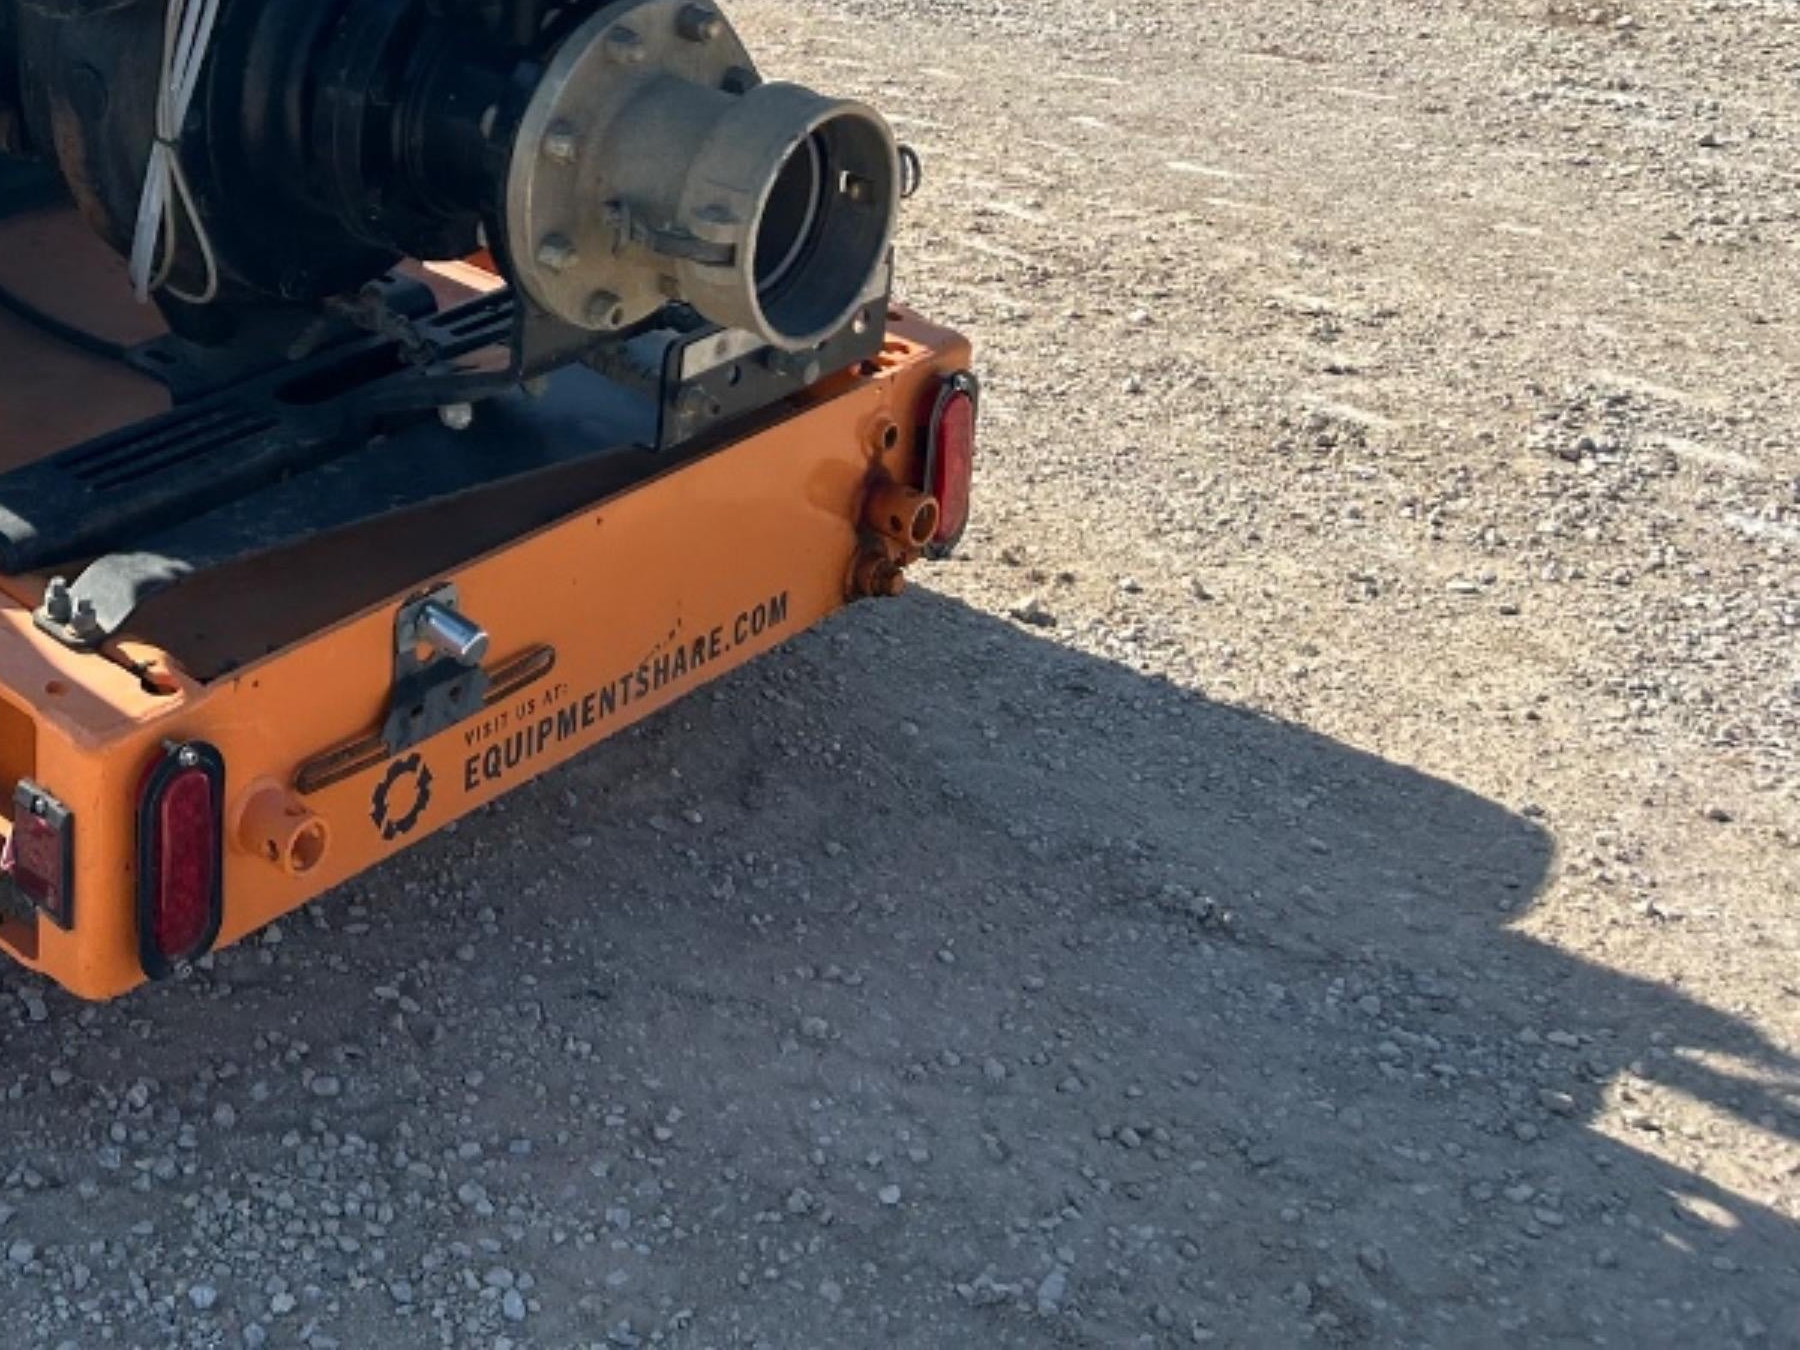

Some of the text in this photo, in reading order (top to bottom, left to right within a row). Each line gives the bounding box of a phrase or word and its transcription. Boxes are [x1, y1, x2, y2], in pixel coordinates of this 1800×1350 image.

[463, 590, 788, 793] EQUIPMENTSHARE.COM
[464, 683, 568, 747] VISIT US AT:
